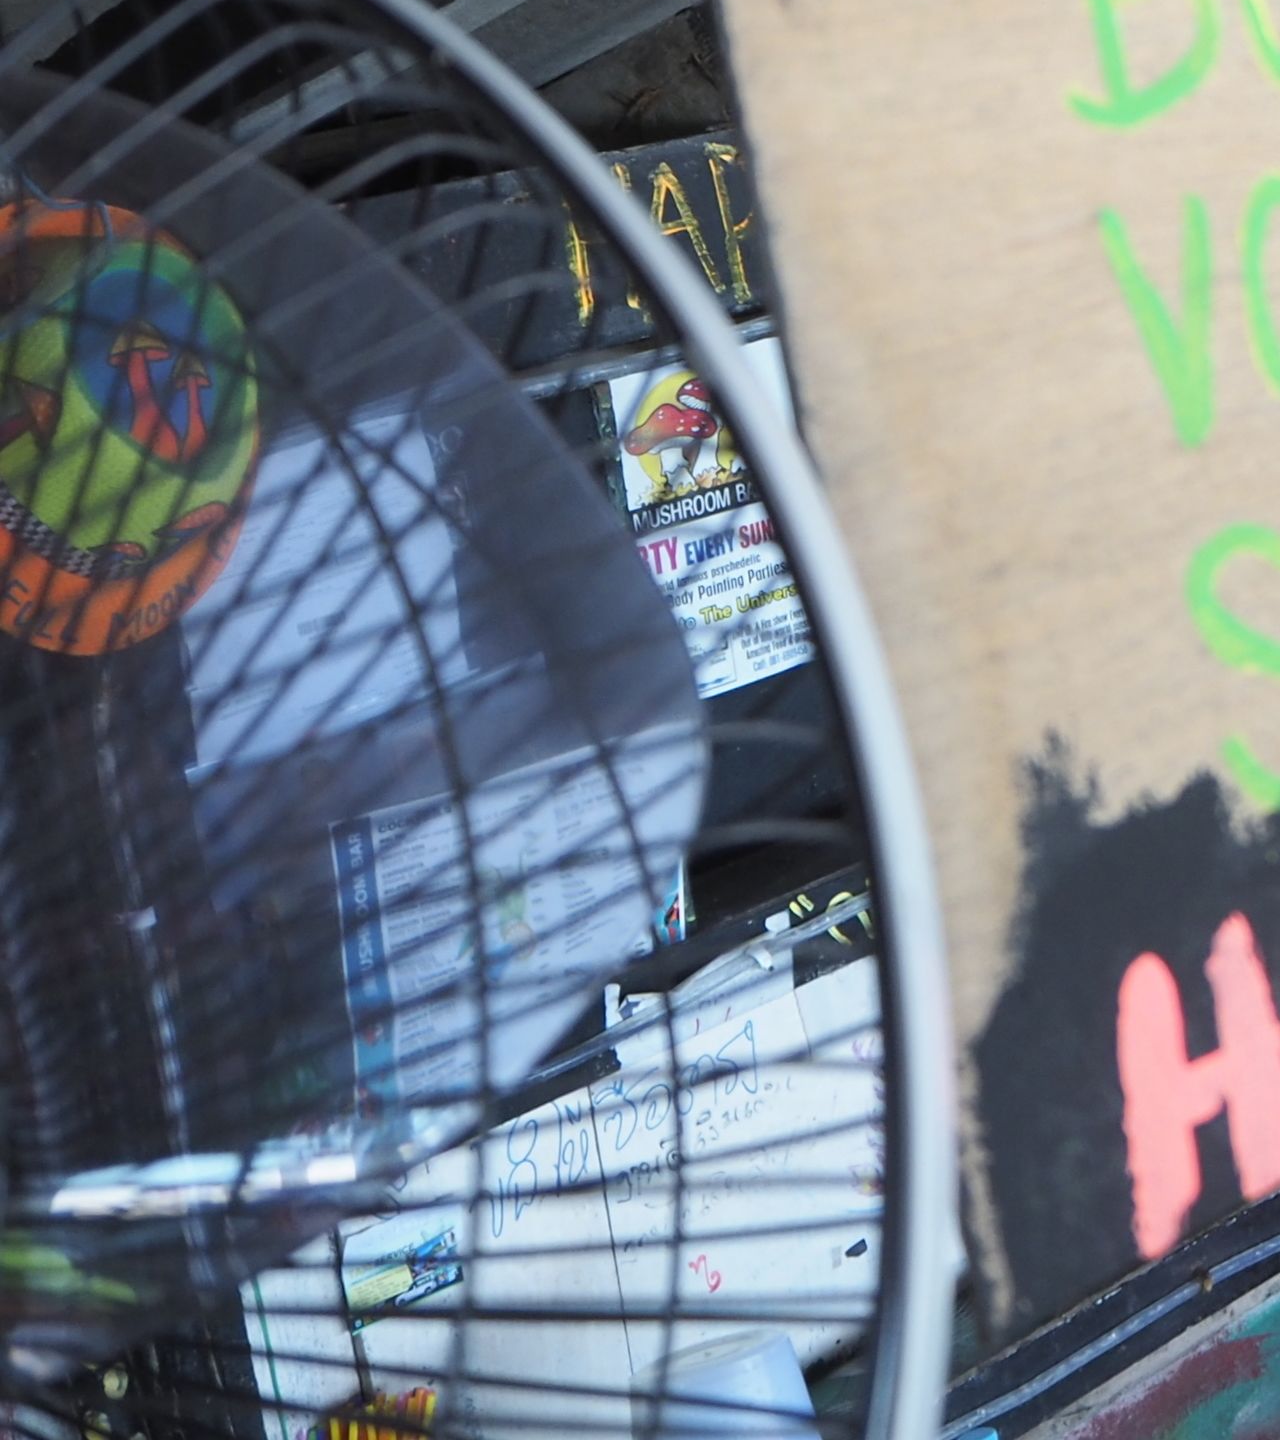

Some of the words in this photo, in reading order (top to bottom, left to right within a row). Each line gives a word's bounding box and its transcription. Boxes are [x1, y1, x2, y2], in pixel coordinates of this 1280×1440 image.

[633, 488, 731, 533] MUSHROOM
[684, 528, 735, 567] EVERY
[738, 516, 777, 549] SUN
[697, 574, 745, 601] Painting
[747, 560, 788, 586] Parties
[711, 553, 762, 578] psychedelic
[699, 603, 733, 626] The
[735, 582, 800, 614] Univers
